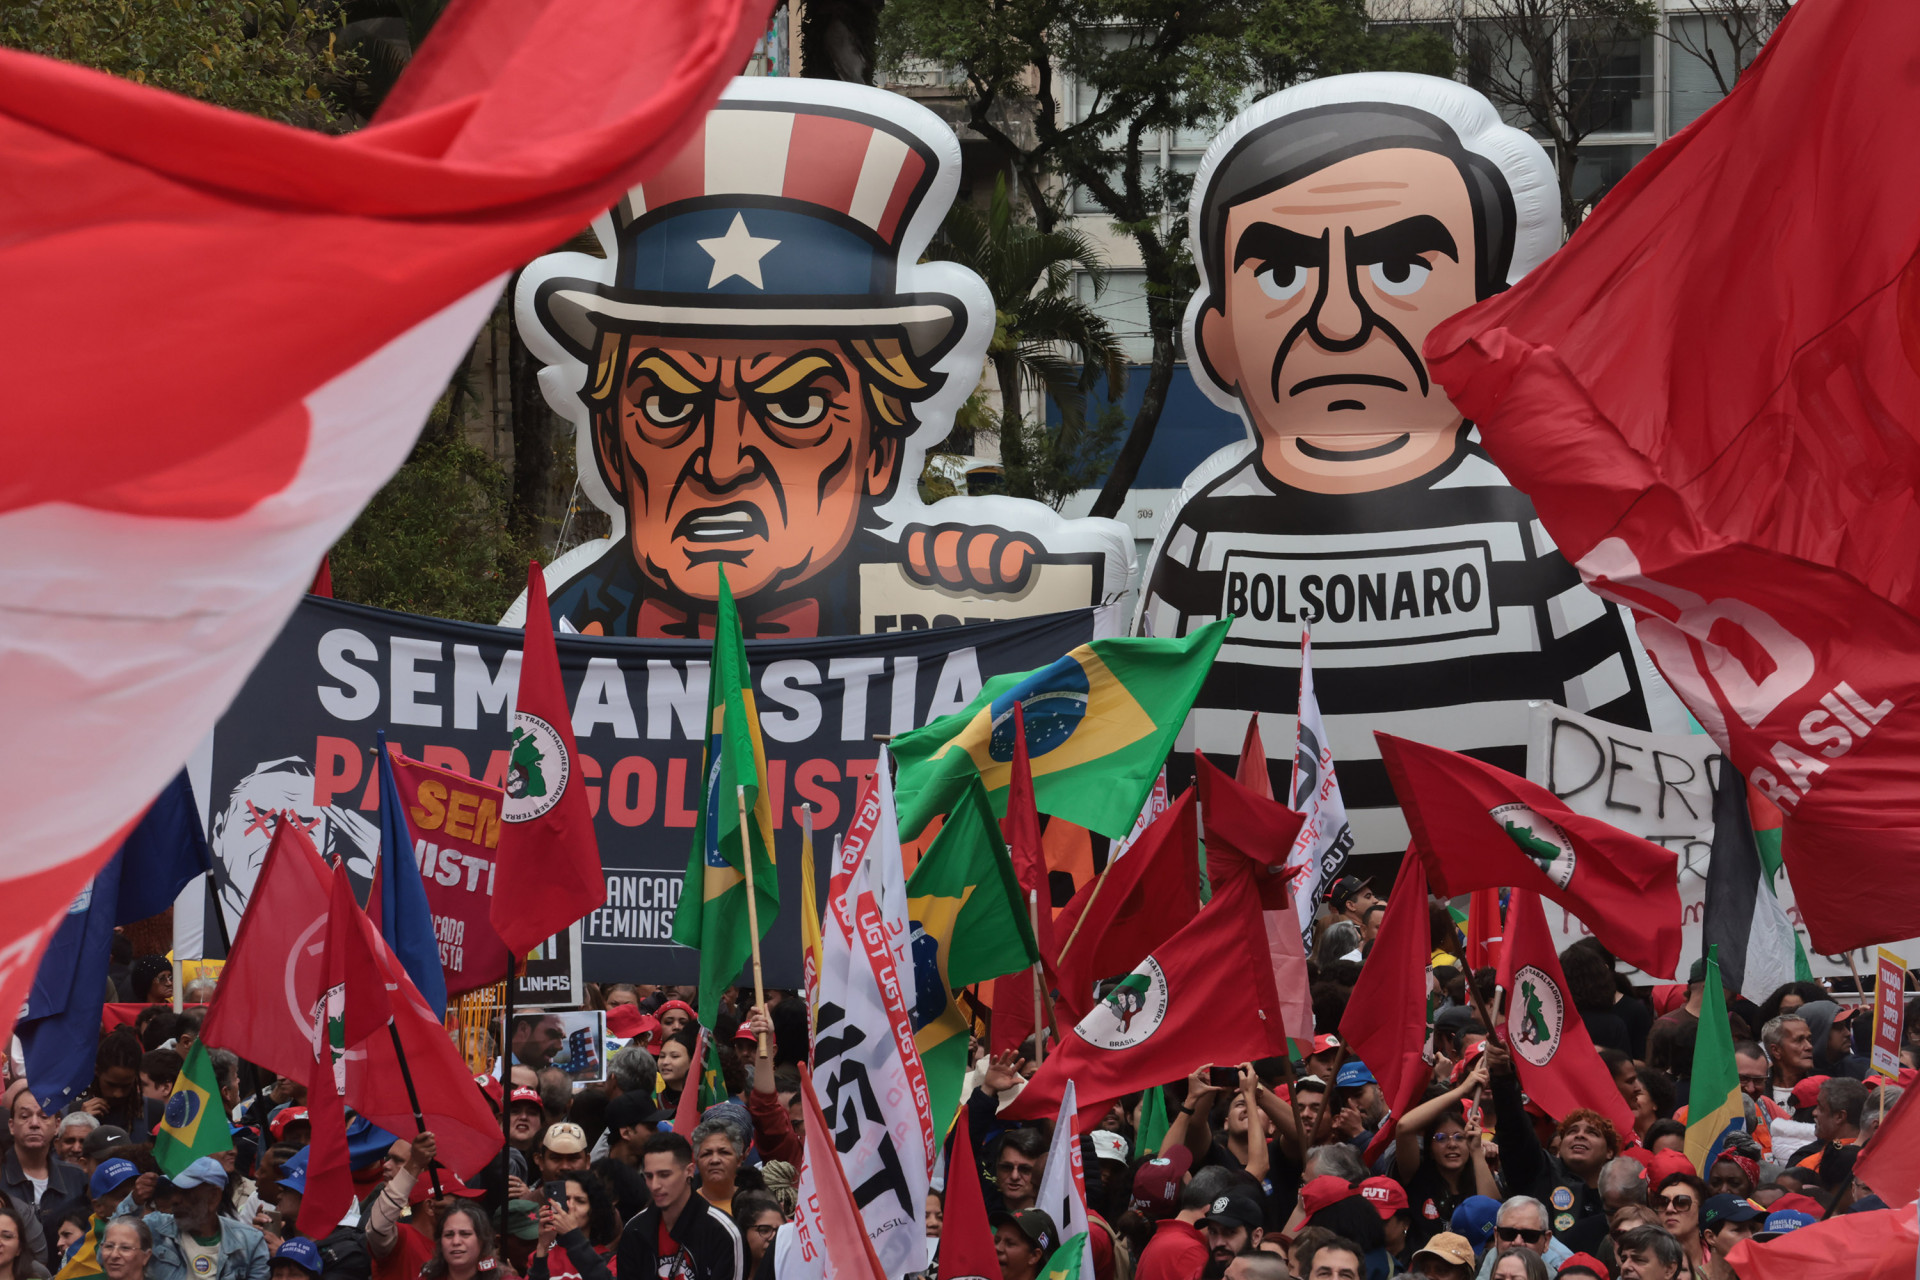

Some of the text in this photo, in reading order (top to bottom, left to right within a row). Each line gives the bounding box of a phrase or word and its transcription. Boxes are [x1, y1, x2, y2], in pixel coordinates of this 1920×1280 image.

[1227, 562, 1481, 624] BOLSONARO
[317, 628, 984, 743] SEM ANSTIA
[525, 715, 568, 772] TRABALHADORES
[1750, 680, 1895, 818] RASIL
[549, 774, 567, 802] RURAIS
[505, 811, 532, 820] TERRA
[534, 802, 550, 815] SEM
[607, 875, 684, 909] ANCAD
[589, 908, 676, 940] FEMINIS
[860, 910, 889, 959] UGT
[879, 966, 905, 1013] UGT
[519, 975, 570, 992] LINHAS
[1157, 979, 1167, 996] SEM
[1153, 998, 1167, 1024] TERRA
[1109, 1037, 1137, 1048] BRASIL
[868, 1216, 908, 1241] RASIL
